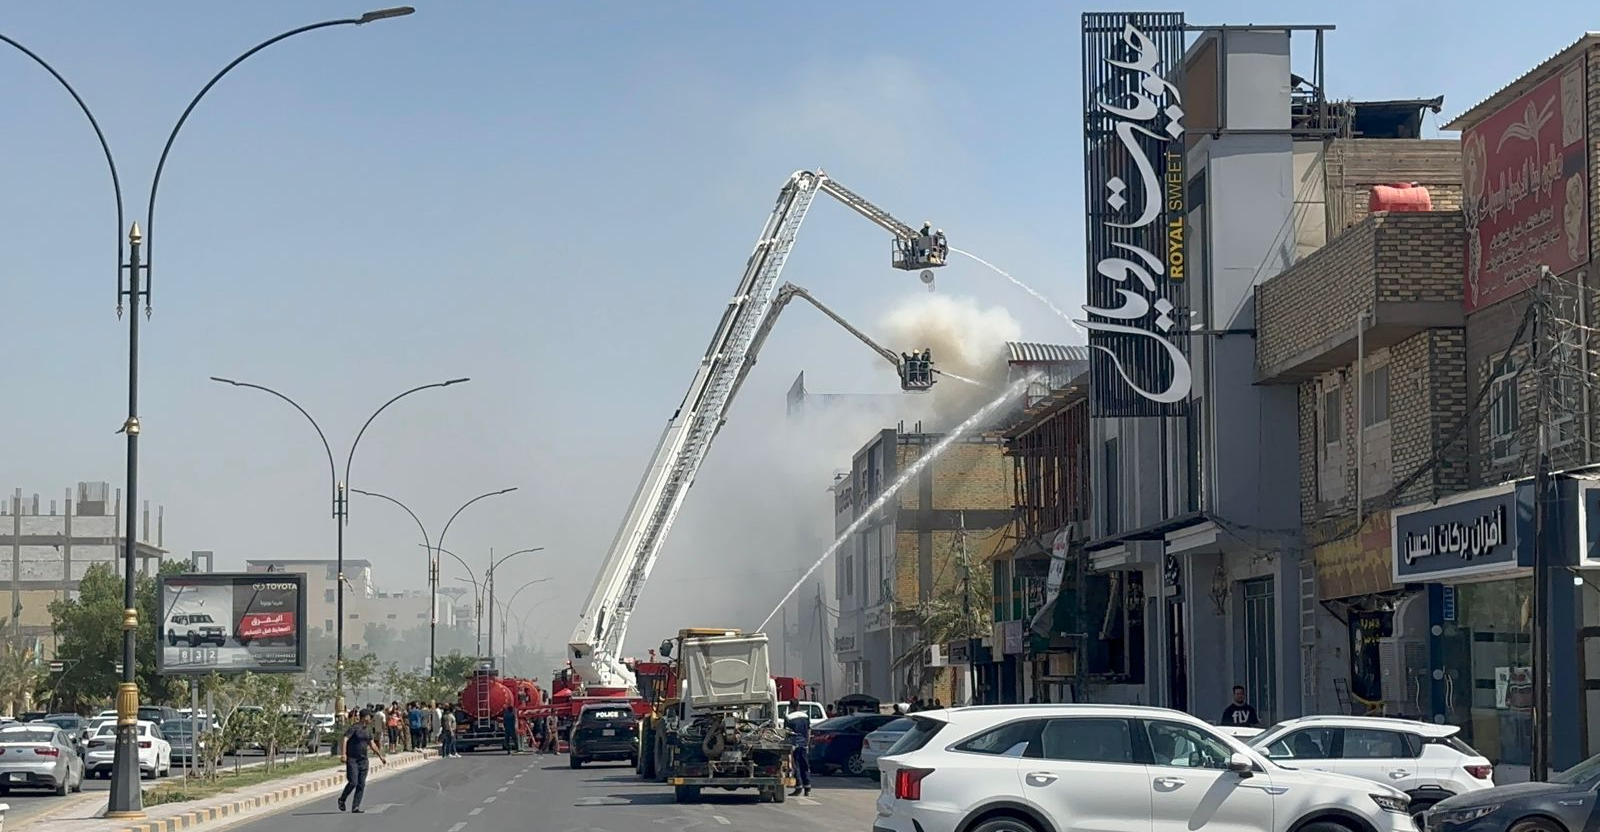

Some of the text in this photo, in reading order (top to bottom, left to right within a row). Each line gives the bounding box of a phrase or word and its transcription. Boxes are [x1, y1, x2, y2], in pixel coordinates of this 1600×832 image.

[1072, 22, 1192, 404] حلويات رويال
[1169, 150, 1184, 280] ROYAL SWEET
[1404, 525, 1436, 565] الحسن
[1438, 522, 1469, 559] بركات
[1471, 505, 1503, 556] أفران
[266, 582, 298, 590] TOYOTA
